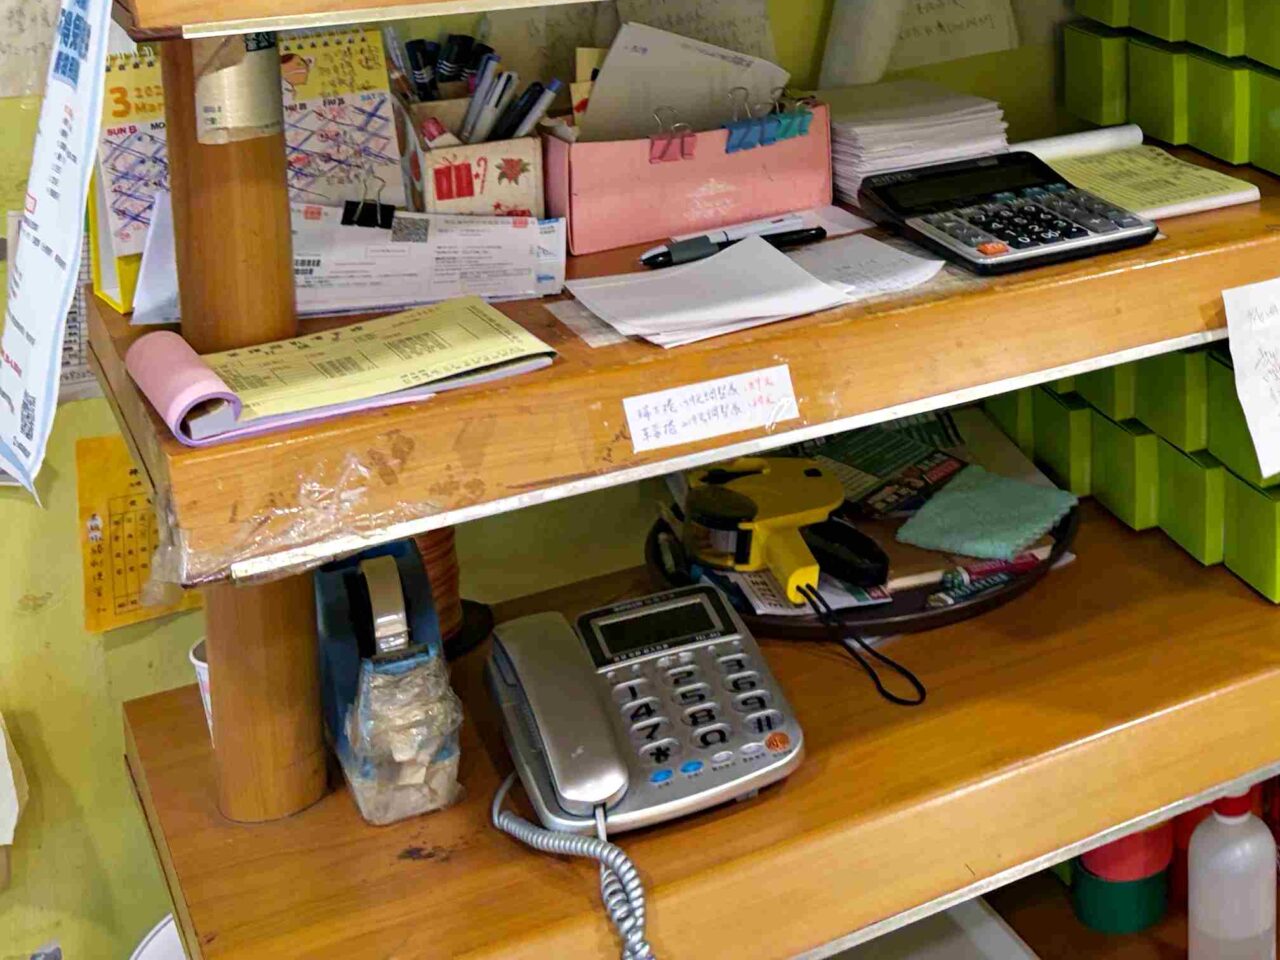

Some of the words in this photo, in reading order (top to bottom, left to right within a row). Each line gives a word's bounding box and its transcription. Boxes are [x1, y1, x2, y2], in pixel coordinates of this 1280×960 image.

[110, 86, 132, 118] 3
[107, 126, 127, 137] SUN
[150, 121, 166, 131] MO
